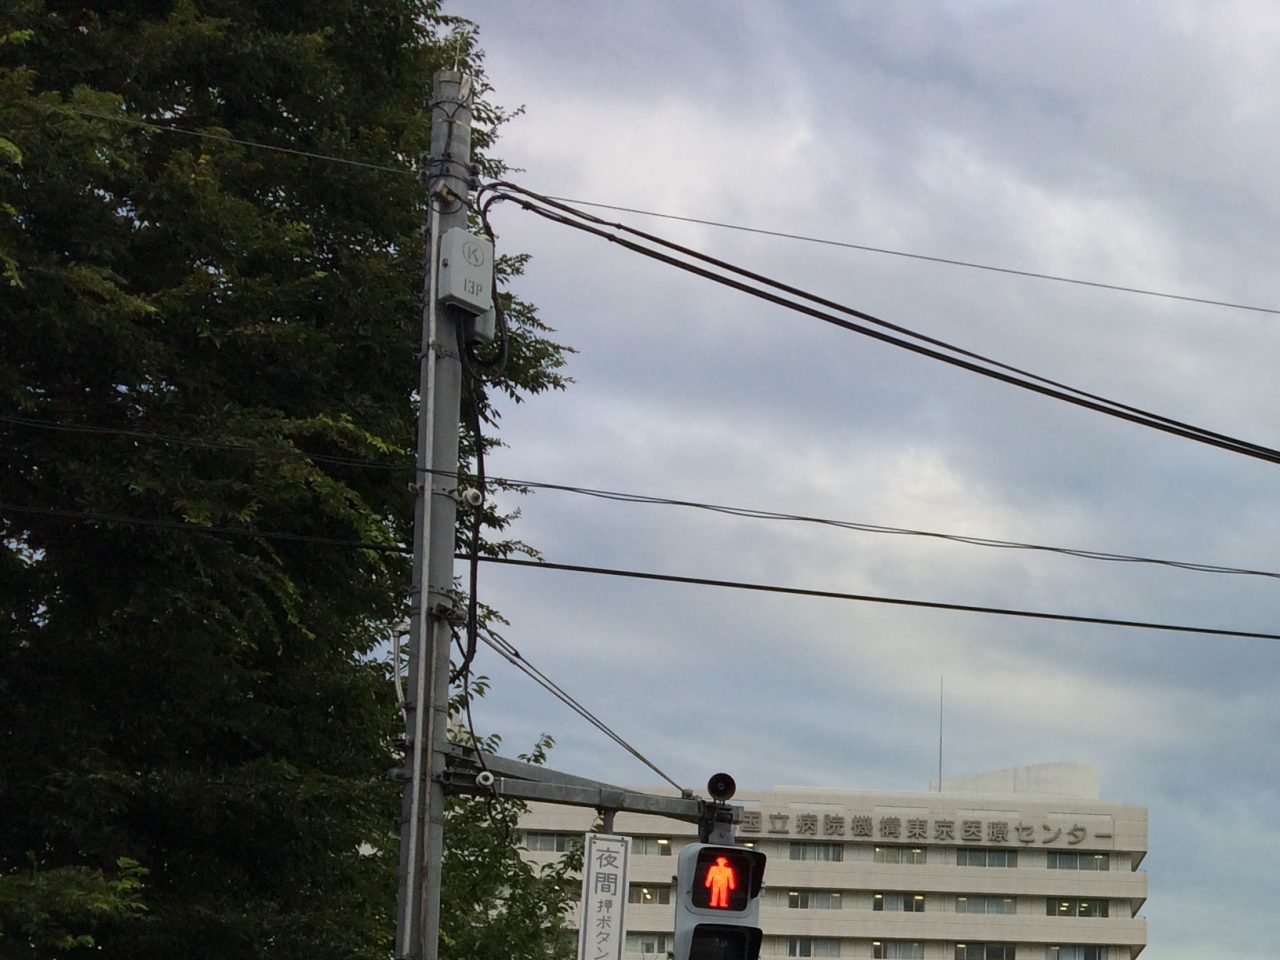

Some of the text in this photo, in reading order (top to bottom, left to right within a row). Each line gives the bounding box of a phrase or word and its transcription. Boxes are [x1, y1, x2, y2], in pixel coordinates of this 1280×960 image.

[740, 811, 1113, 844] 国立病院機構東京医療センター
